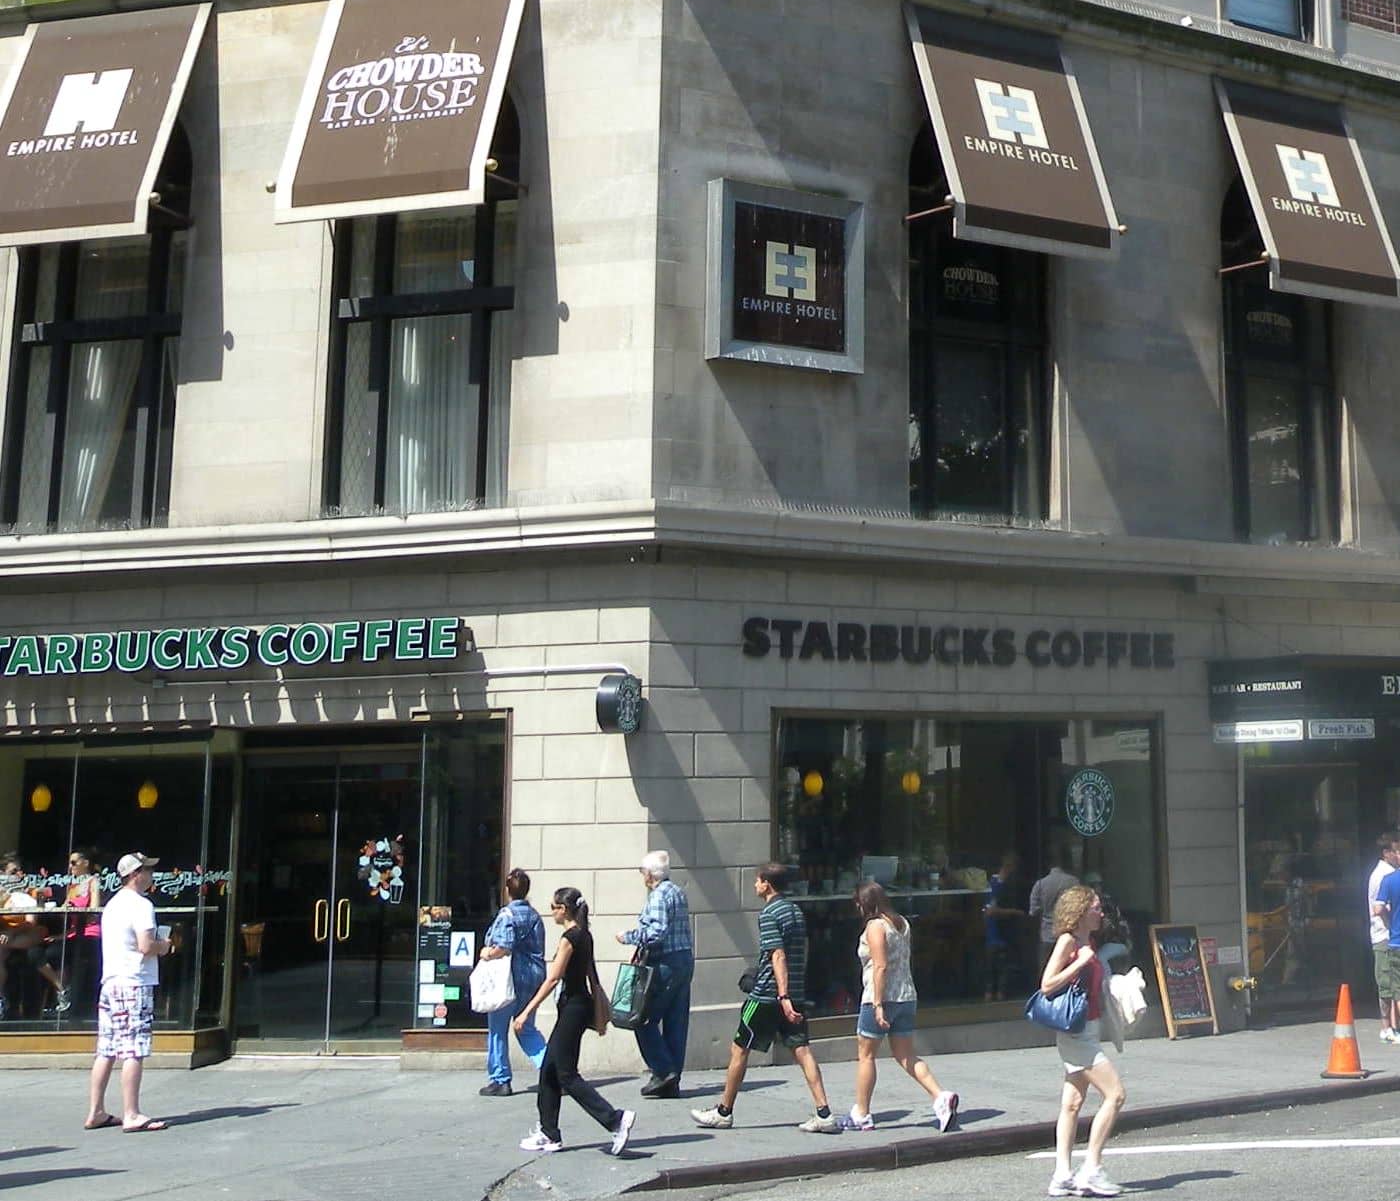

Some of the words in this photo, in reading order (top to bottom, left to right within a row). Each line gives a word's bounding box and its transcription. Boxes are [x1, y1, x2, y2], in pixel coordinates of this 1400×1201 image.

[327, 52, 485, 91] CHOWDER
[319, 77, 478, 123] HOUSE
[391, 107, 465, 122] RESTAURANT
[7, 135, 76, 156] EMPIRE
[80, 130, 138, 149] HOTEL
[964, 136, 1025, 160] EMPIRE
[1028, 148, 1079, 171] HOTEL
[1271, 197, 1322, 218] EMPIRE
[1324, 207, 1367, 227] HOTEL
[742, 296, 792, 315] EMPIRE
[796, 303, 838, 321] HOTEL
[257, 616, 460, 670] COFFEE
[742, 616, 1016, 667] STARBUCKS
[1025, 629, 1176, 668] COFFEE
[1252, 680, 1302, 692] RESTAURANT
[1346, 723, 1367, 734] Fish
[455, 936, 470, 957] A
